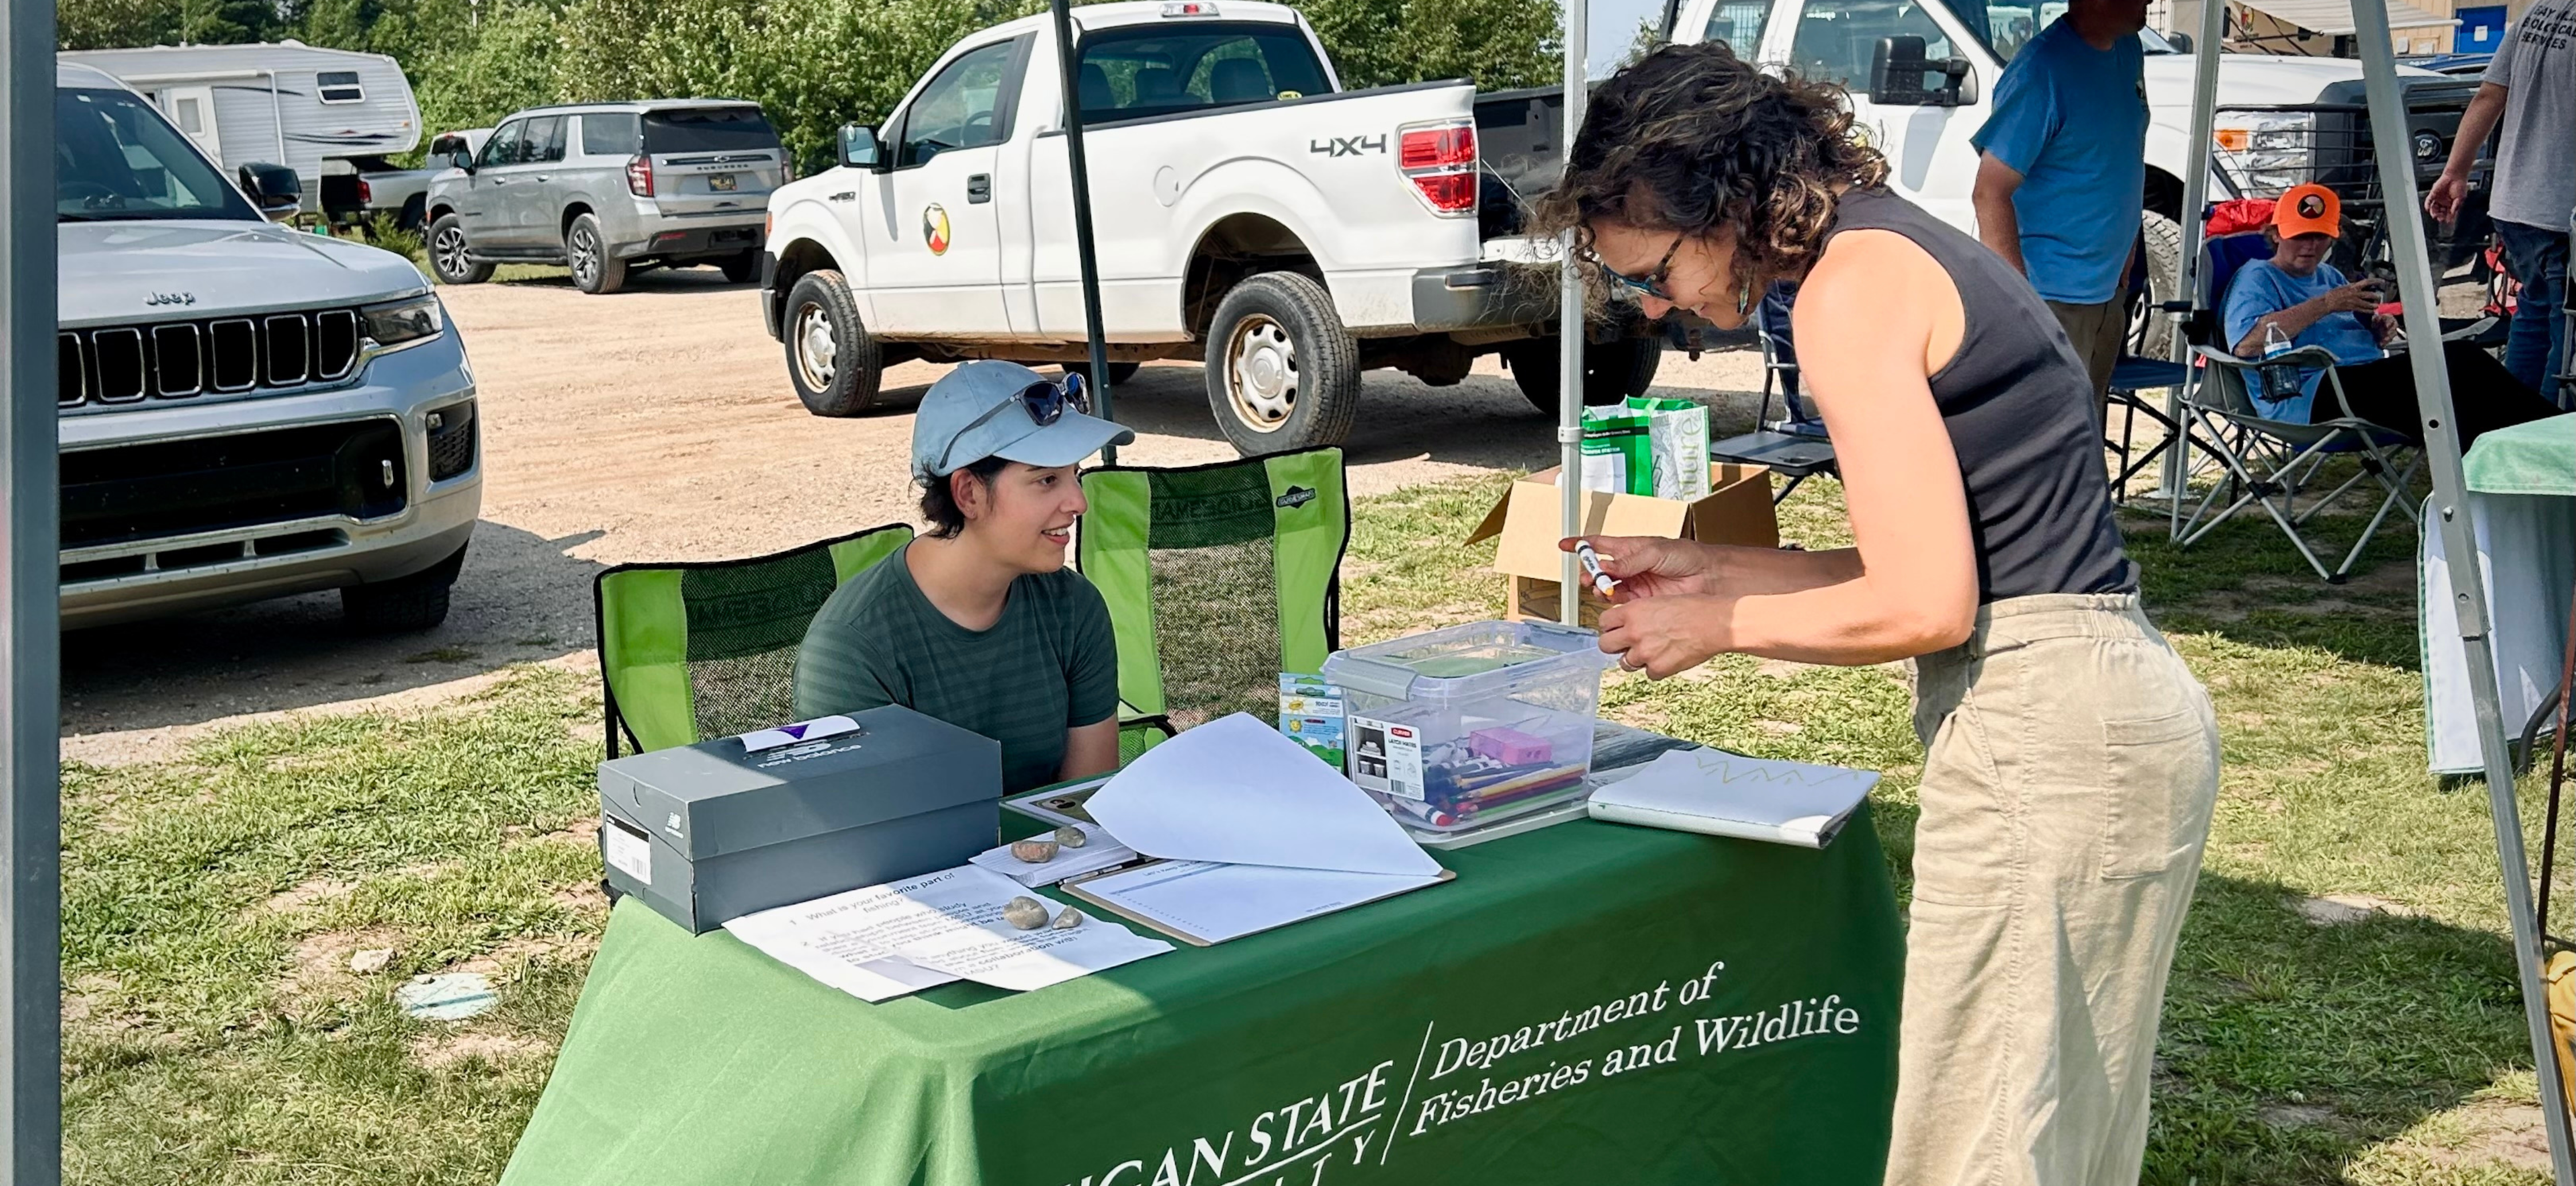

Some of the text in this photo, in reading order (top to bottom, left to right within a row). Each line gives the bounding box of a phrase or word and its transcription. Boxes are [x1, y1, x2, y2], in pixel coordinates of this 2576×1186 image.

[143, 291, 196, 306] Jeep
[792, 744, 862, 761] balance
[805, 908, 837, 920] What
[850, 898, 874, 910] your
[875, 884, 919, 900] favorite
[920, 876, 944, 889] part
[945, 872, 955, 880] of
[863, 897, 904, 914] fishing?
[876, 915, 912, 928] people
[914, 909, 937, 918] who
[938, 902, 967, 912] study
[930, 946, 978, 959] anything
[978, 941, 1054, 965] collaboration
[1055, 935, 1078, 944] with
[1429, 960, 1725, 1080] Department of
[1409, 994, 1859, 1137] Fisheries and Wildlife
[1245, 1060, 1393, 1167] STATE
[1275, 1129, 1376, 1186] TY
